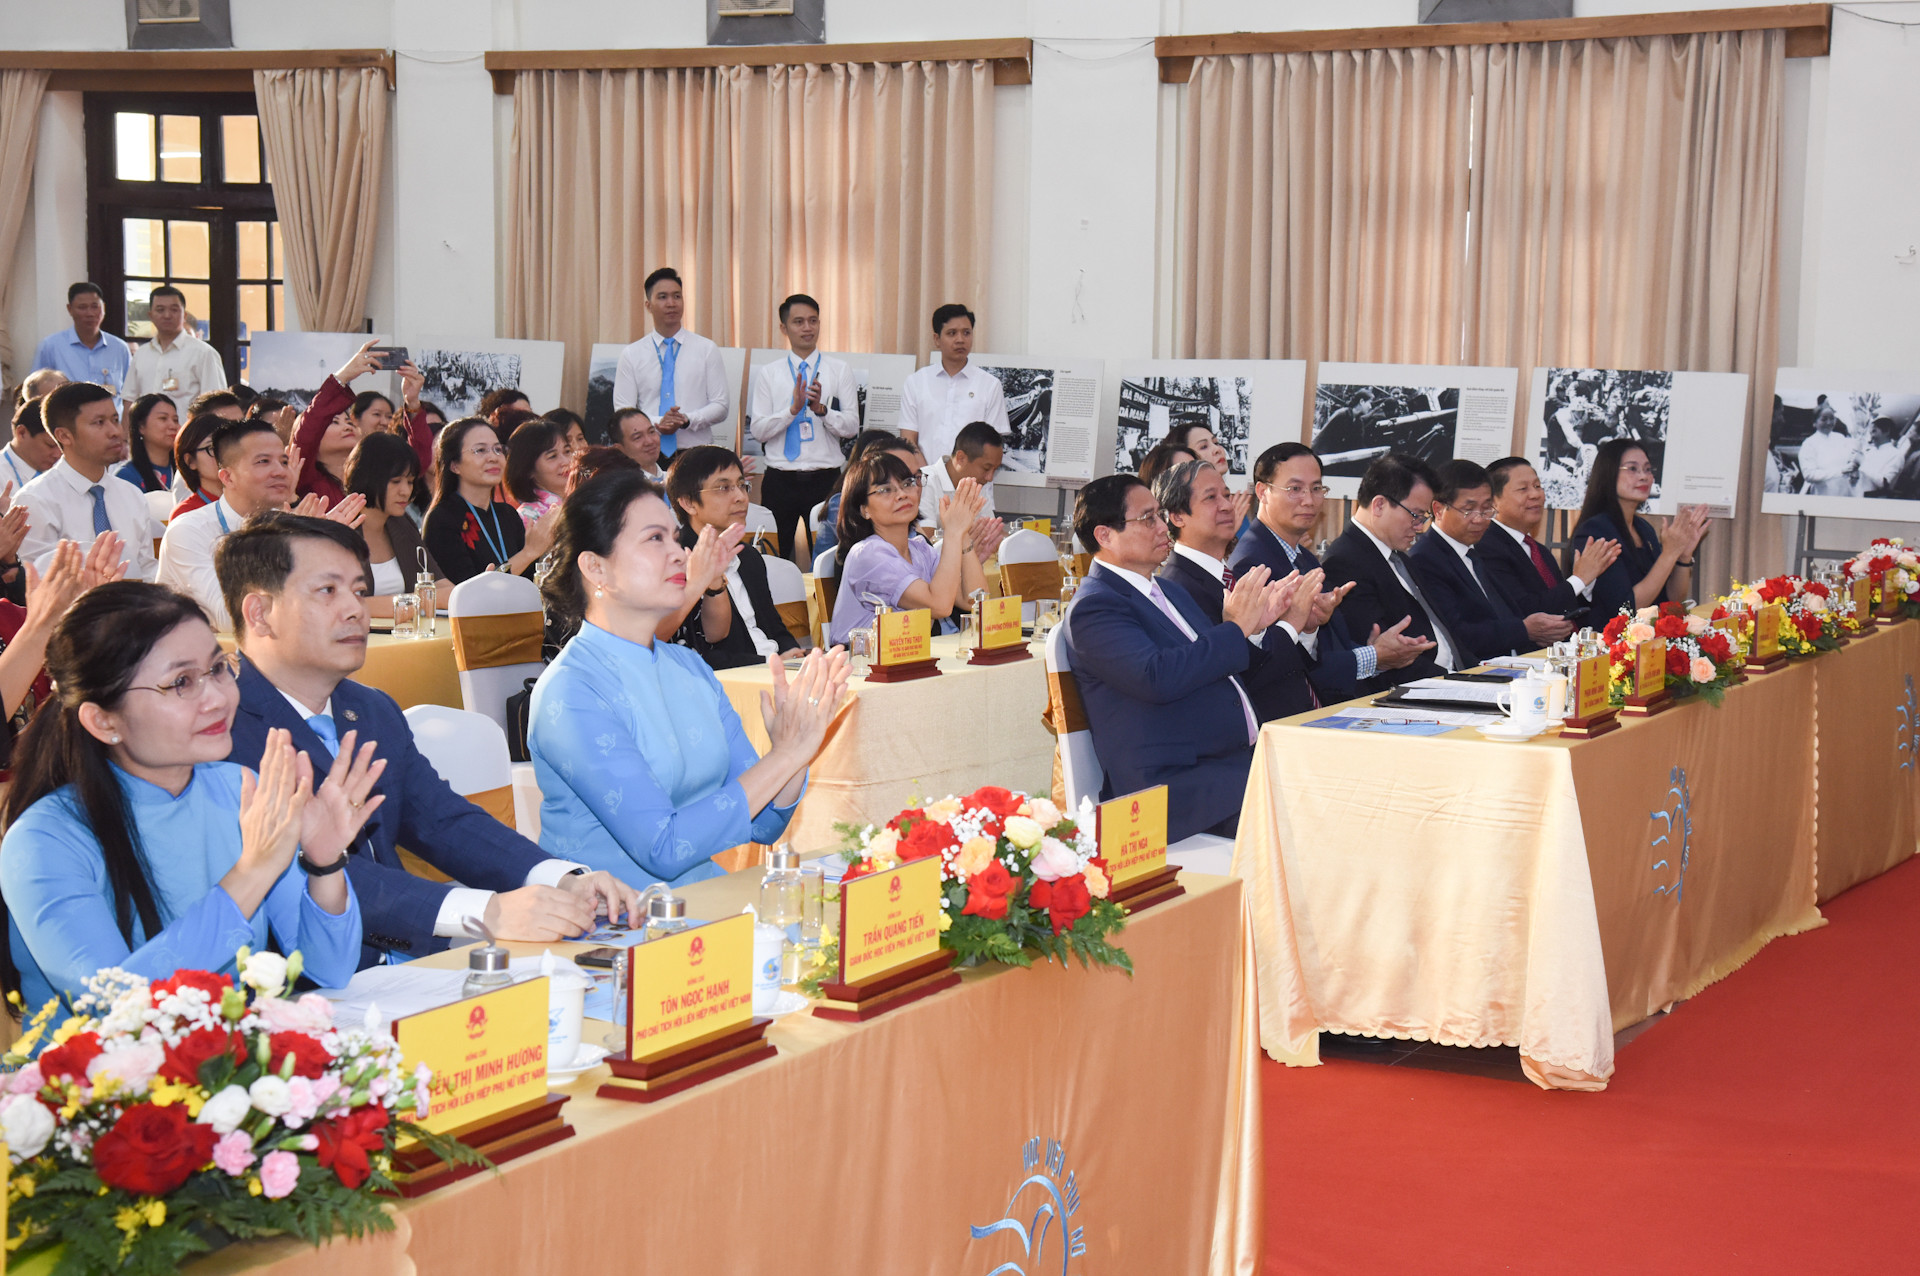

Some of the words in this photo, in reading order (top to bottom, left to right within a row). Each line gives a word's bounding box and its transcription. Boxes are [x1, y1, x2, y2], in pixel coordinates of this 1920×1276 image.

[884, 919, 907, 941] QUANG
[660, 995, 679, 1016] TÔN
[681, 988, 704, 1009] NGỌC
[706, 979, 730, 1002] HẠNH
[453, 1068, 472, 1090] THỊ
[476, 1057, 503, 1082] MINH
[507, 1044, 543, 1075] HƯƠNG
